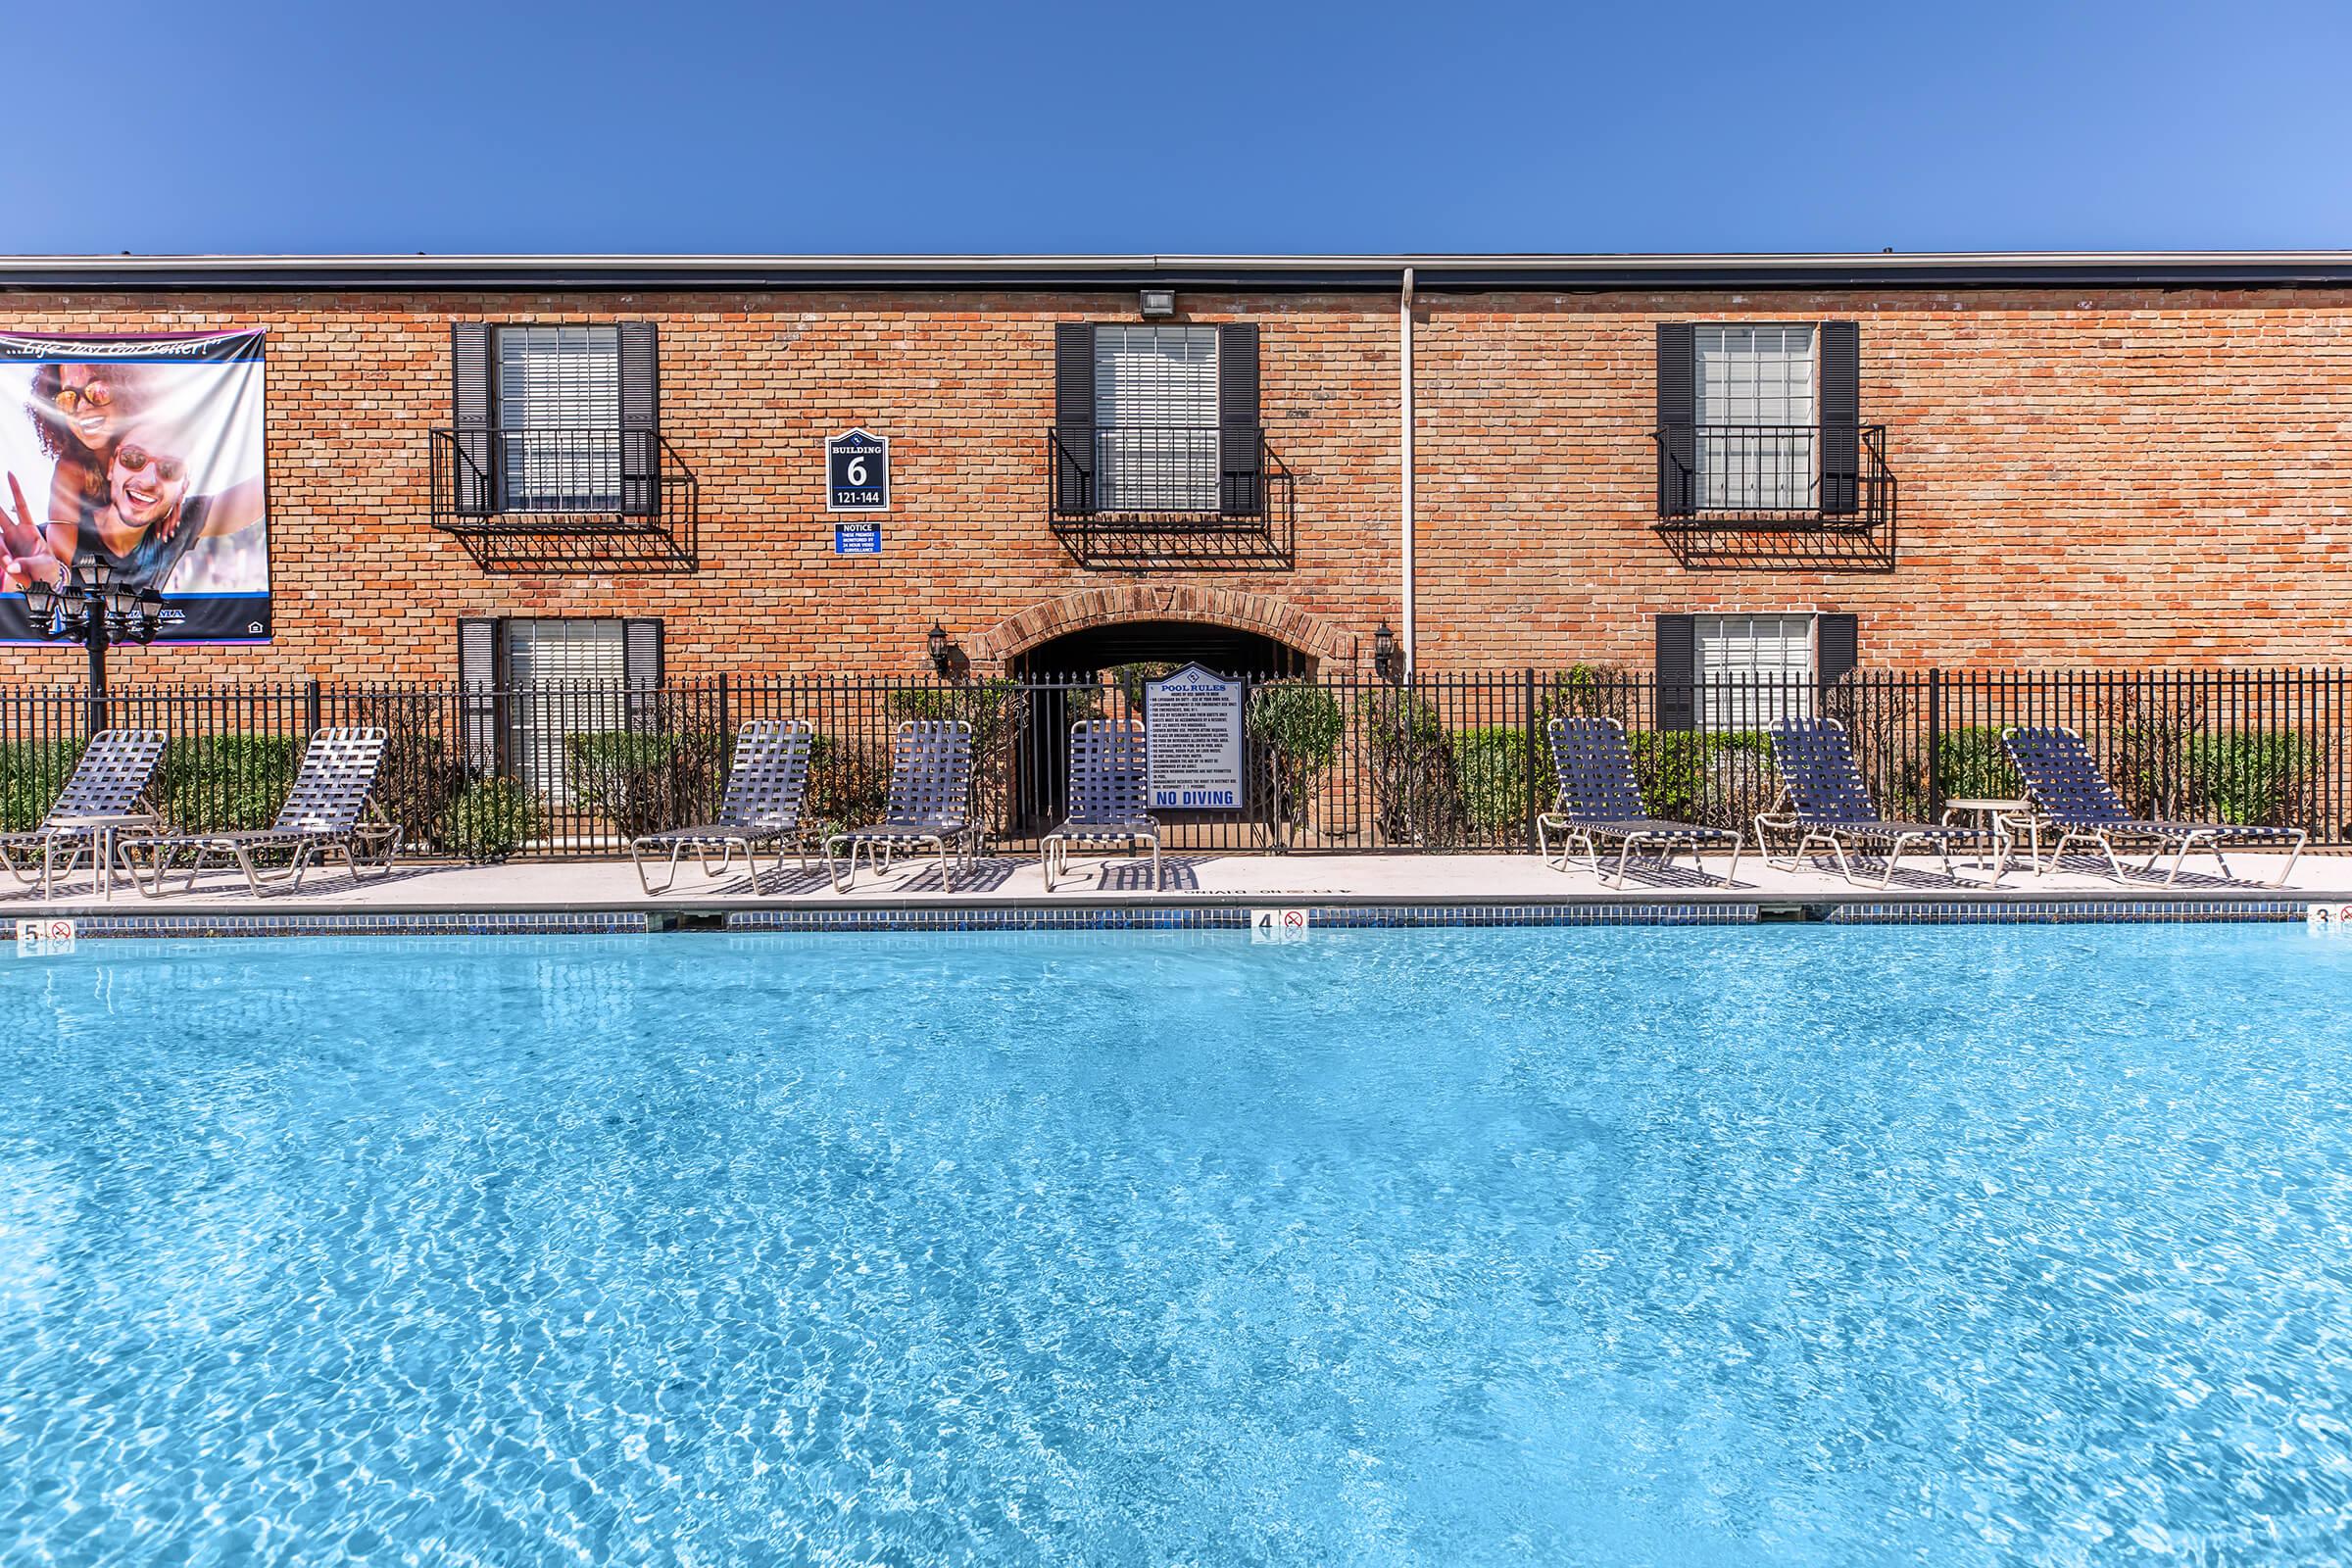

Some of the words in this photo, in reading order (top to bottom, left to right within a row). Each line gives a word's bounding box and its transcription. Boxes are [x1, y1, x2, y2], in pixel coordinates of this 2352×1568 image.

[832, 446, 882, 455] BUILDING
[848, 456, 867, 486] 6
[837, 491, 880, 504] 121-144
[844, 523, 872, 532] NOTICE
[1156, 791, 1177, 806] NO
[1183, 791, 1233, 806] DIVING
[1258, 913, 1272, 927] 4
[2316, 908, 2329, 923] 3
[25, 924, 38, 940] 5
